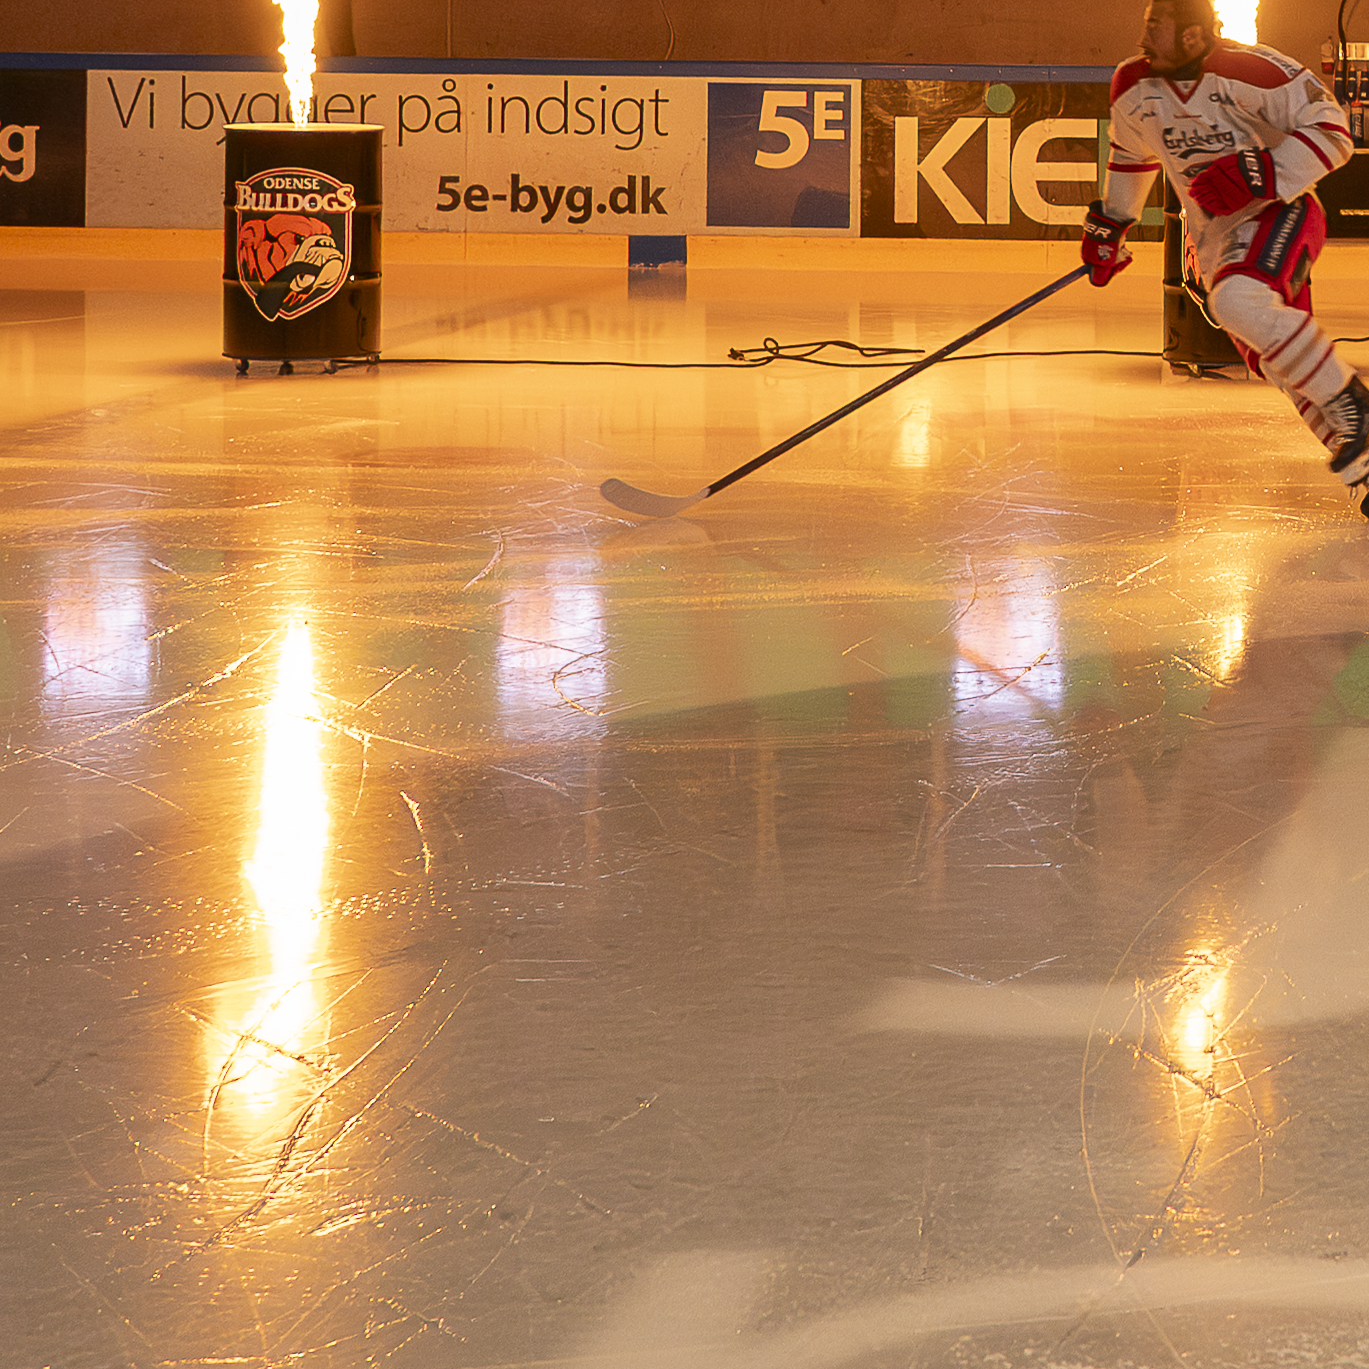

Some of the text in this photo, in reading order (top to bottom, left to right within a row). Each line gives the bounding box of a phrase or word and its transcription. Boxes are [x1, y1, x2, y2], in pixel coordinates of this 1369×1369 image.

[107, 76, 156, 130] Vi
[398, 78, 464, 147] på
[486, 83, 670, 152] indsigt
[754, 89, 846, 170] 5E
[236, 184, 353, 213] BULLDOGS
[263, 176, 321, 191] ODENSE
[435, 175, 669, 224] 5e-byg.dk
